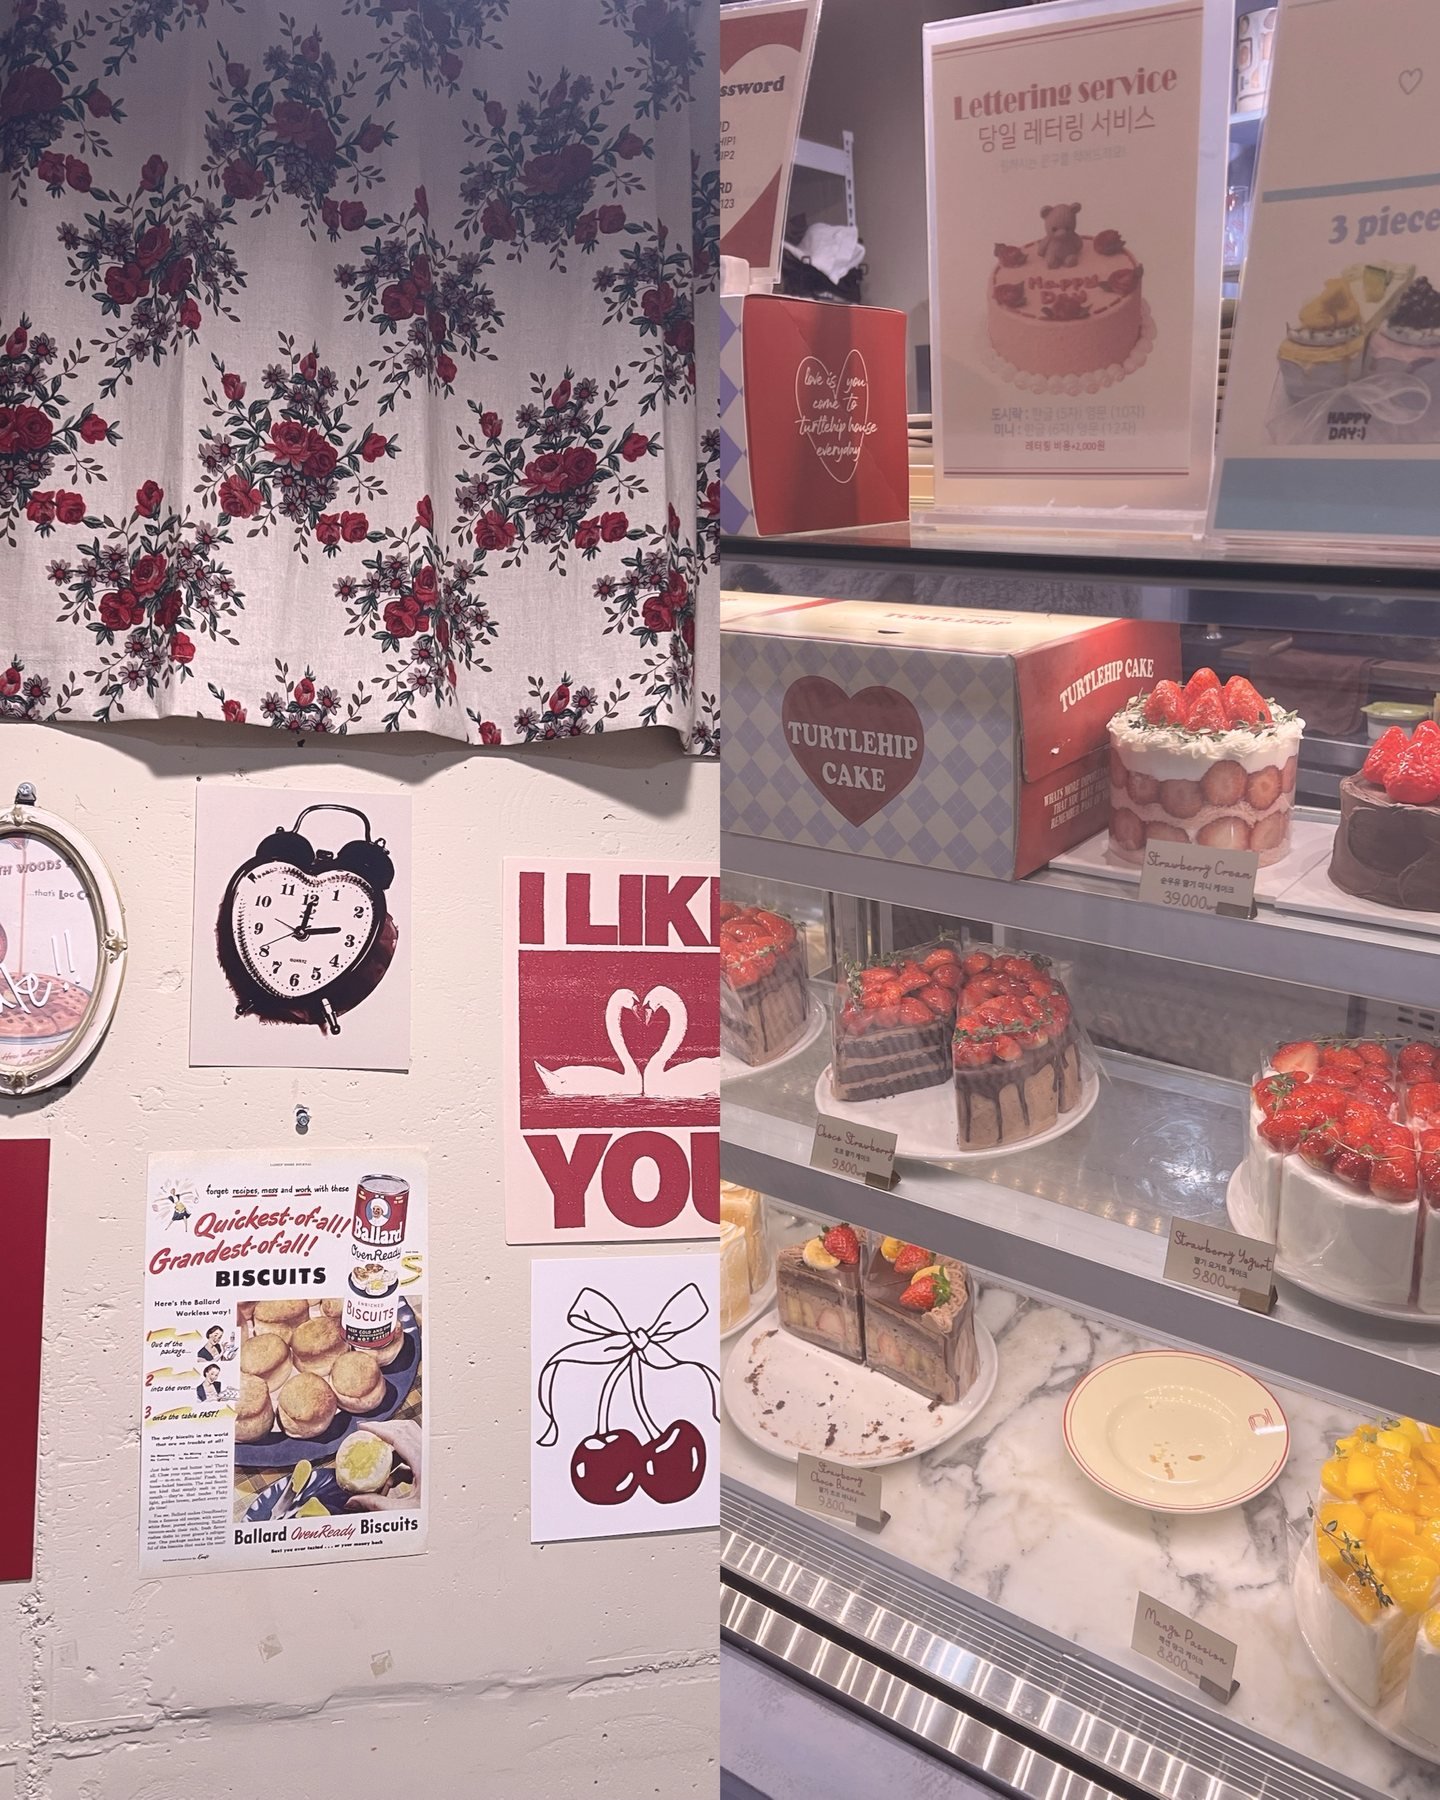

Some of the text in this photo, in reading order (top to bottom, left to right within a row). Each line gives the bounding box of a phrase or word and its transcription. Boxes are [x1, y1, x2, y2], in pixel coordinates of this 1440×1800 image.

[954, 67, 1177, 121] Lettering service
[979, 105, 1156, 153] 당일 레터링 서비스
[1328, 206, 1440, 245] 3 piece
[805, 367, 866, 394] love is you
[813, 393, 859, 412] come to
[1327, 412, 1371, 426] HAPPY
[795, 415, 878, 441] turtlehip house
[994, 423, 1015, 437] 미니
[816, 441, 861, 463] everyday
[1059, 658, 1154, 713] TURTLEHIP CAKE
[788, 721, 918, 759] TURTLEHIP
[822, 761, 886, 792] CAKE
[17, 860, 62, 874] WOODS
[1147, 851, 1253, 879] Strawberry Cream
[280, 884, 297, 897] 11
[332, 889, 340, 901] 1
[1214, 884, 1234, 894] 케이크
[255, 895, 272, 908] 10
[301, 894, 320, 907] 12
[519, 871, 720, 947] I LIK
[353, 906, 364, 918] 2
[254, 922, 264, 935] 9
[344, 934, 356, 947] 3
[258, 945, 270, 958] 8
[272, 961, 283, 974] 7
[329, 954, 340, 968] 4
[289, 973, 300, 987] 6
[311, 967, 322, 980] 5
[845, 1131, 895, 1161] Strawberry
[206, 1184, 229, 1198] forget
[233, 1187, 260, 1196] recipes,
[281, 1185, 293, 1194] and
[314, 1185, 329, 1193] with
[331, 1185, 350, 1193] these
[194, 1205, 351, 1240] Quickest-of-all!
[353, 1215, 403, 1245] Ballard
[149, 1230, 319, 1275] Grandest-of-all!
[351, 1244, 401, 1261] OvenReady
[1174, 1230, 1272, 1271] Strawberry Yogurt
[215, 1267, 326, 1288] BISCUITS
[1229, 1268, 1248, 1278] 케이크
[346, 1300, 394, 1322] BISCUITS
[358, 1300, 384, 1308] ENRICHED
[176, 1309, 231, 1317] Workless way!
[145, 1374, 154, 1387] 2
[145, 1406, 152, 1419] 3
[199, 1410, 220, 1419] FAST!
[818, 1461, 863, 1487] Strawberry
[837, 1478, 866, 1497] Banana
[234, 1526, 287, 1544] Ballard
[291, 1523, 356, 1541] OvenReady
[360, 1516, 418, 1535] Biscuits
[1145, 1607, 1227, 1665] Mango Passion
